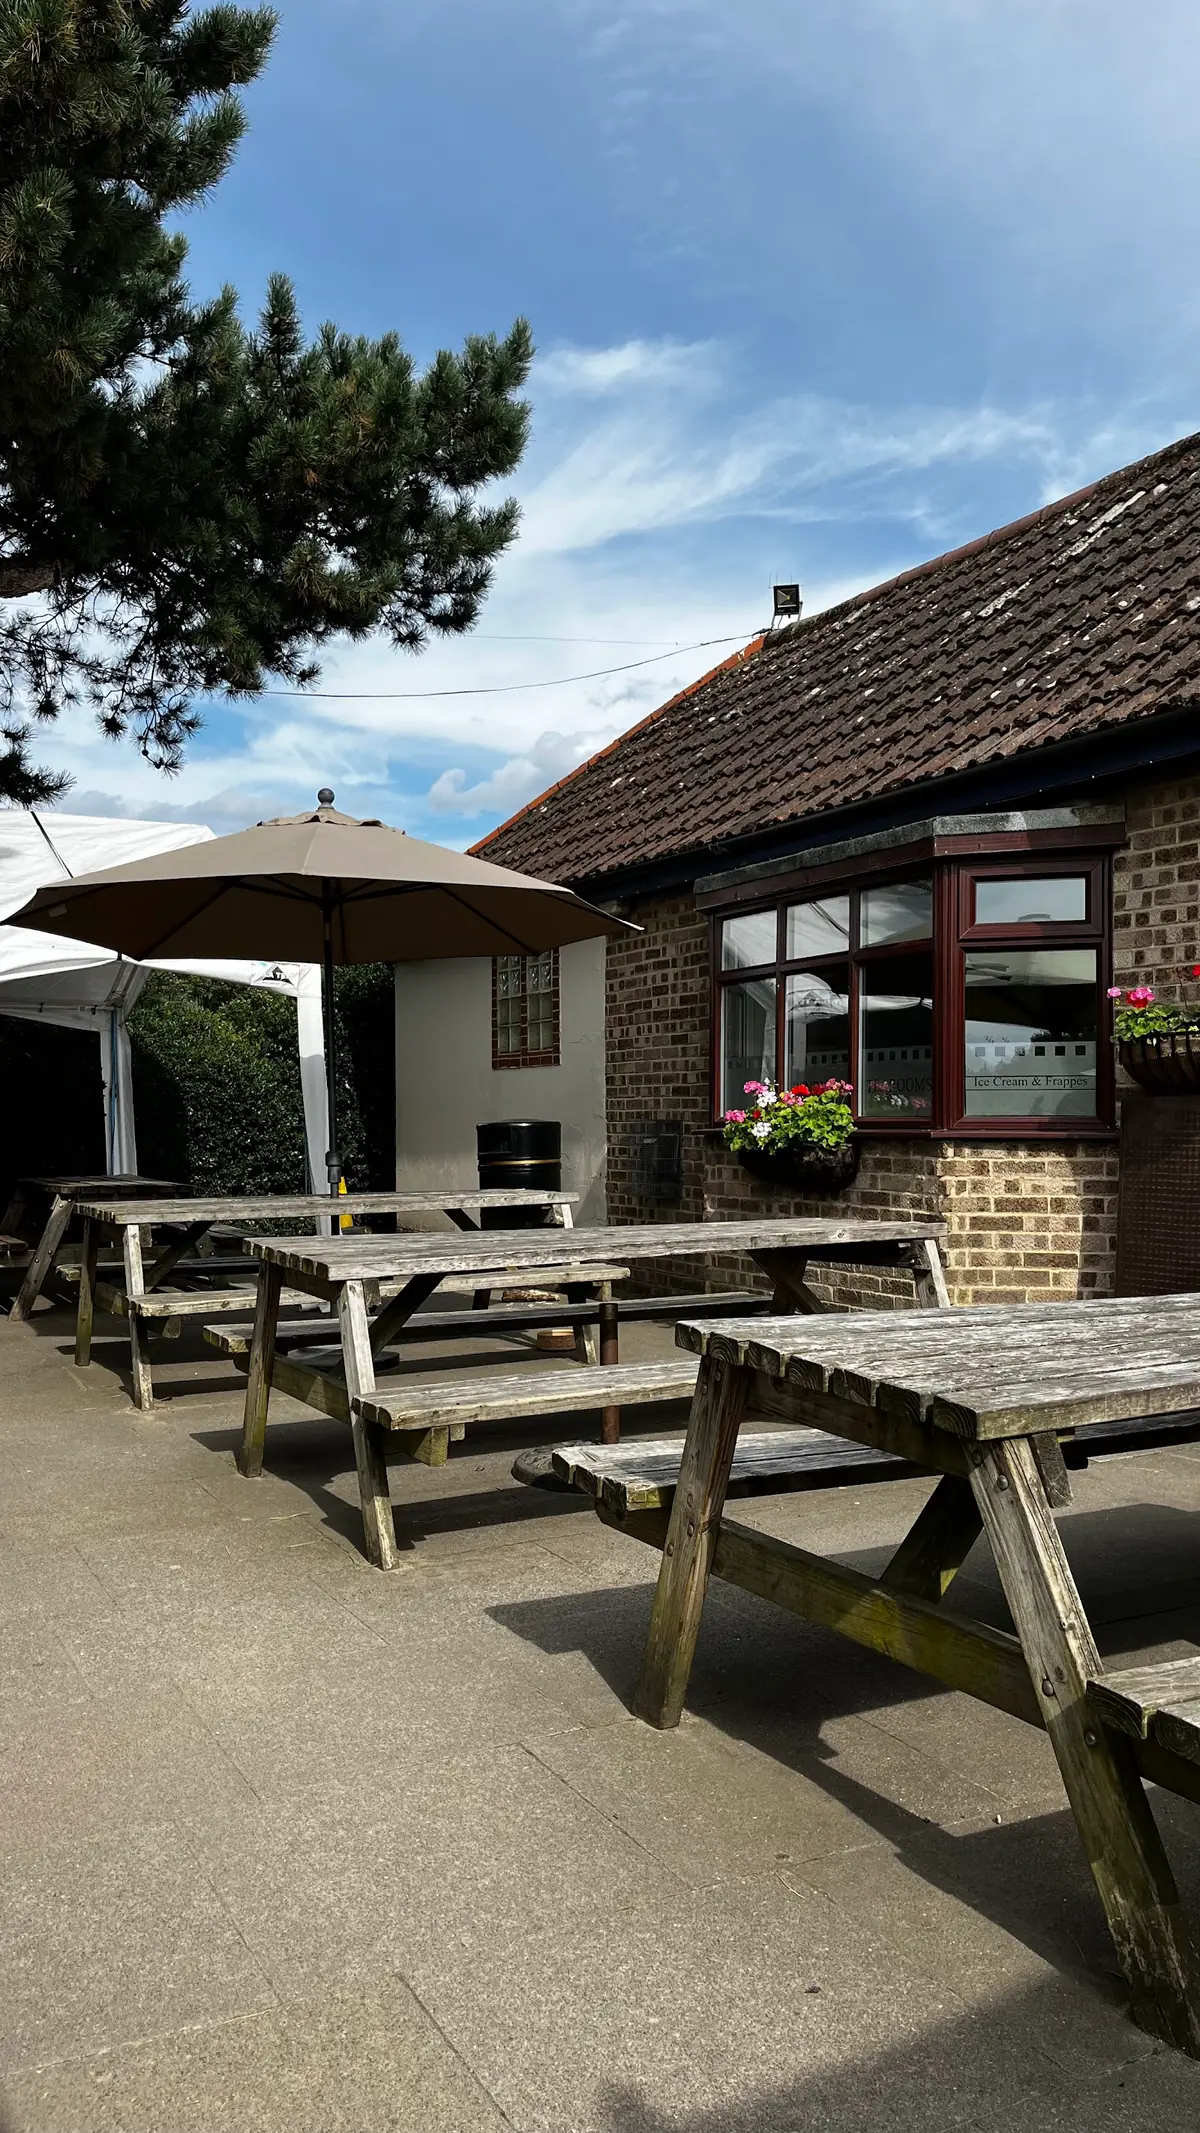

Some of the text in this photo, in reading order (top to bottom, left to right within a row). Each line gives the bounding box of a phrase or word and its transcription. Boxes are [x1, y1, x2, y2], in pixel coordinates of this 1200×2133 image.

[866, 1077, 933, 1093] TROOMS
[974, 1076, 1088, 1088] Ice Cream & Frappes
